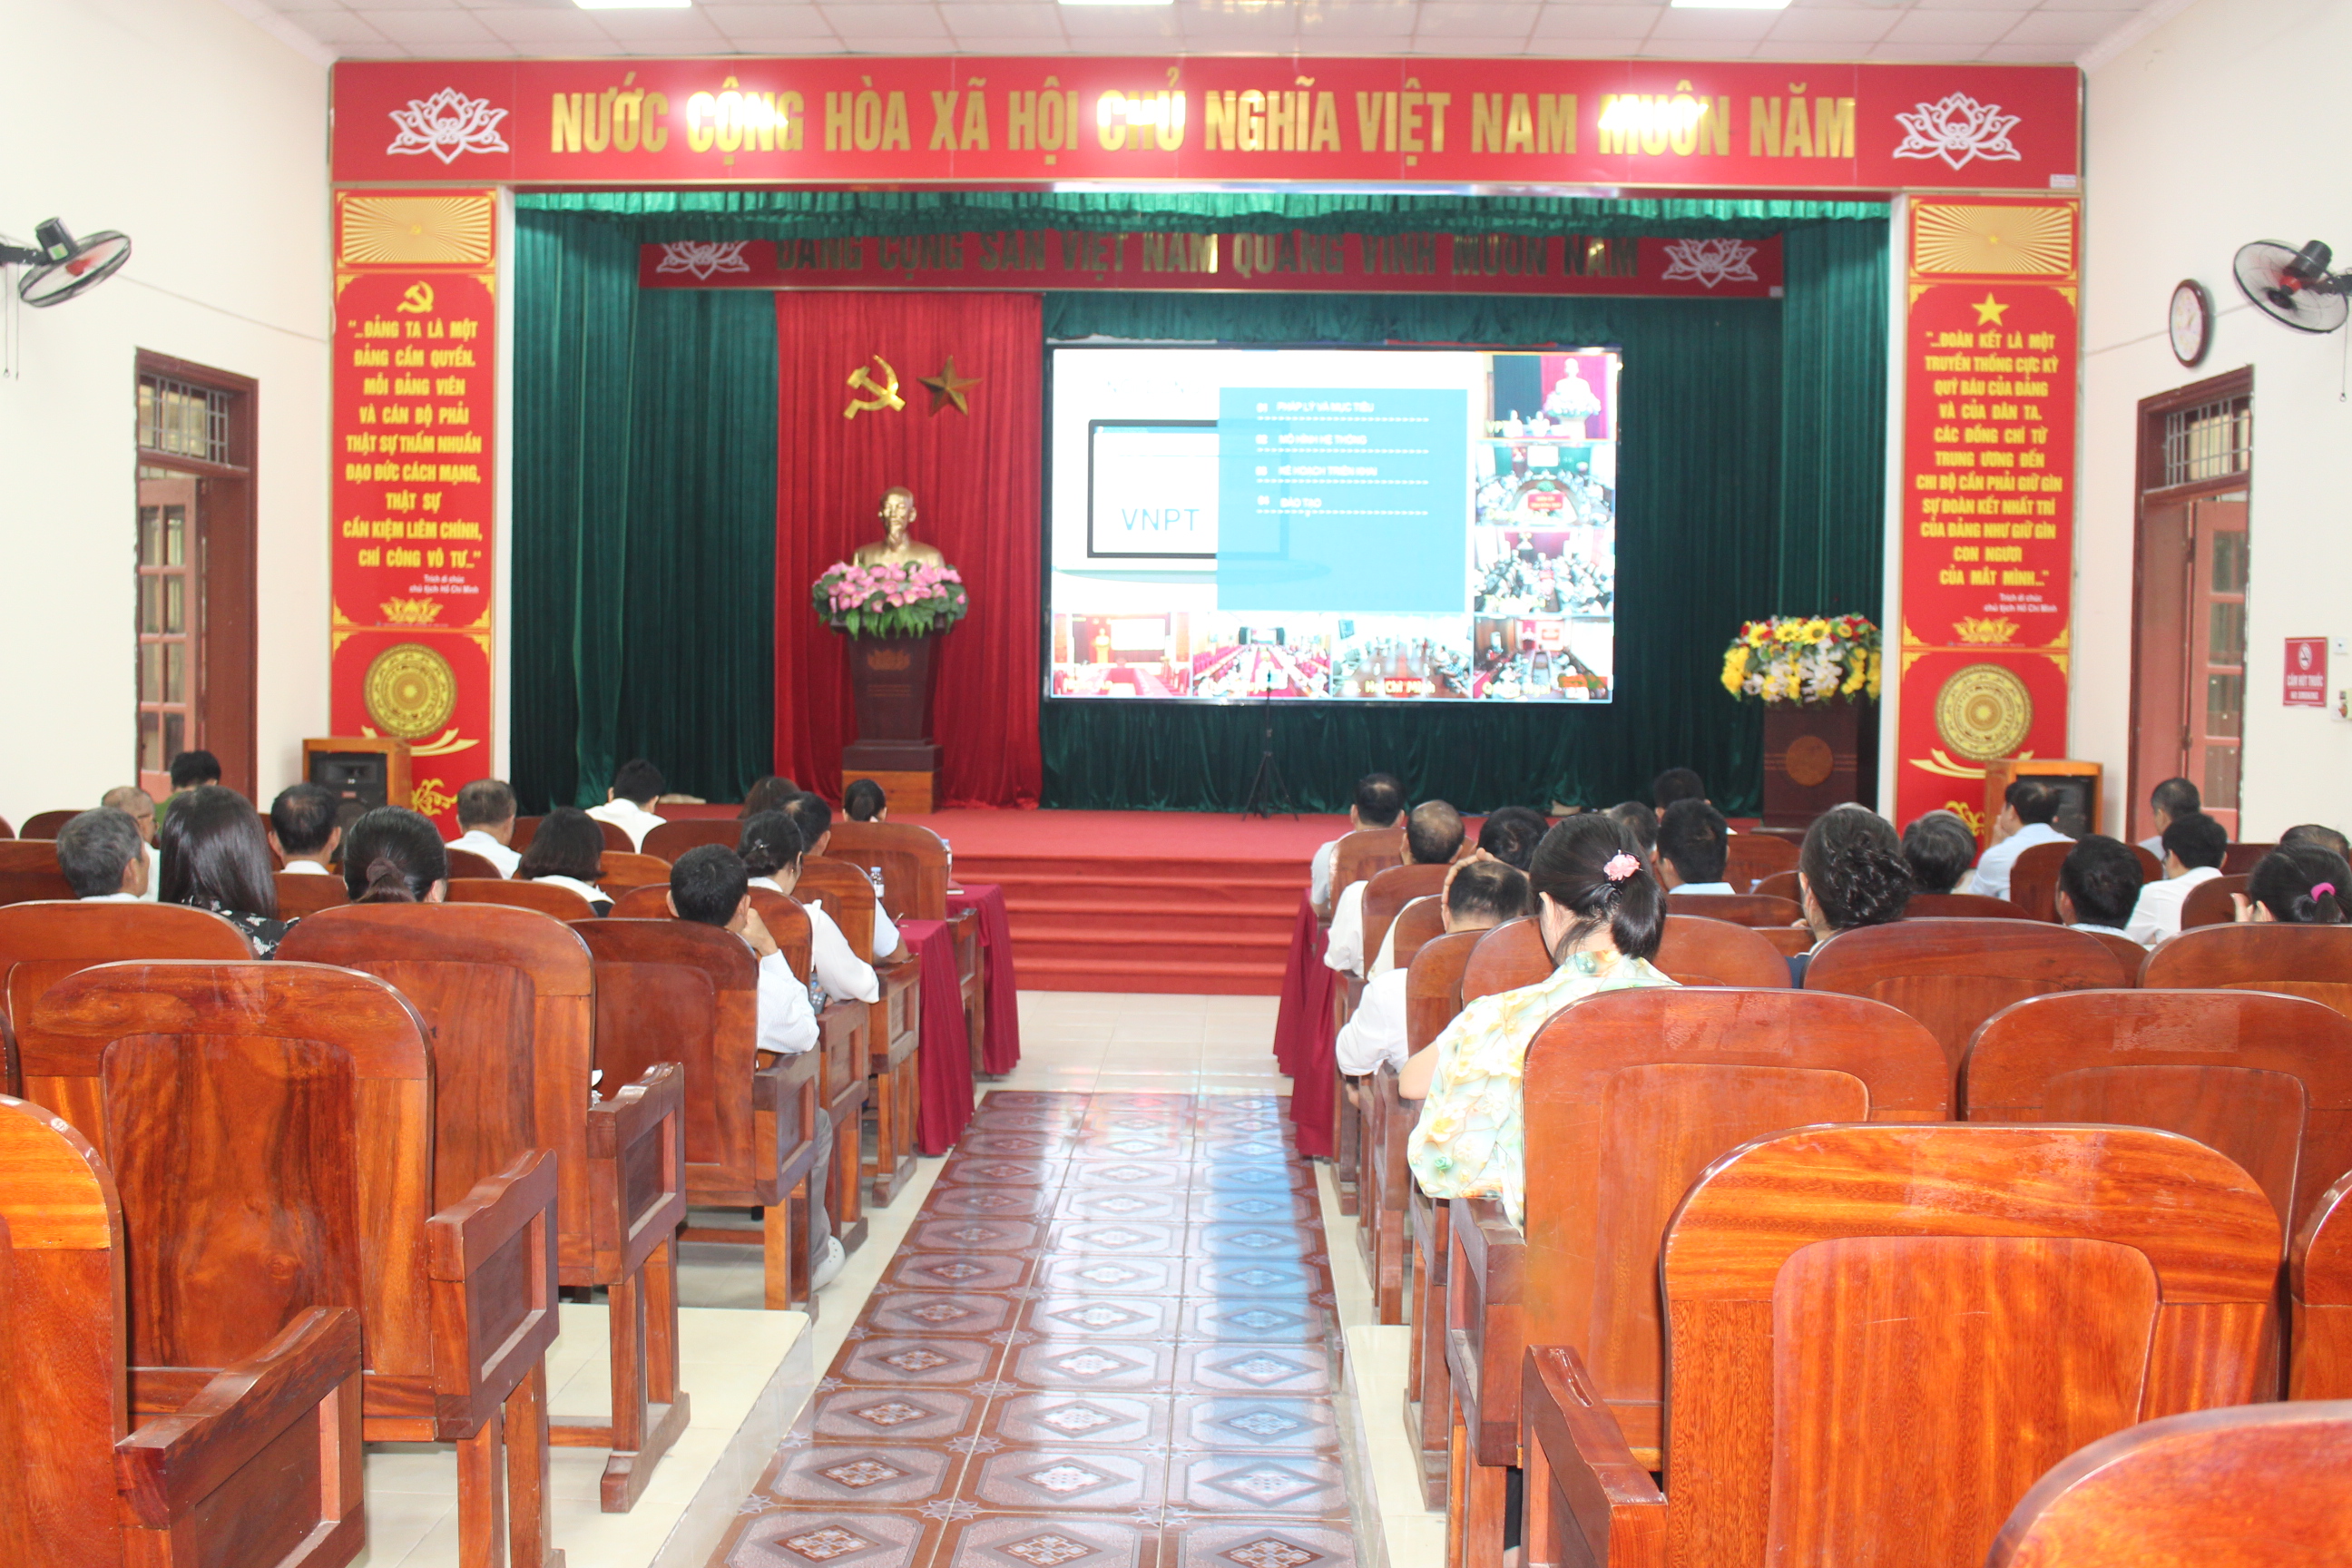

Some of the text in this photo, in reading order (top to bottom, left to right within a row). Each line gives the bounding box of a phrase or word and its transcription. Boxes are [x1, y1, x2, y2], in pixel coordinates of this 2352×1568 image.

[551, 66, 1856, 165] NƯỚC CỘNG HÒA XÃ HỘI CHỦ NGHĨA VIỆT NAM MUÔN NĂM
[1143, 231, 1219, 273] NAM
[1232, 232, 1344, 279] QUANG
[1366, 232, 1436, 276] VINH
[1122, 508, 1200, 531] VNPT
